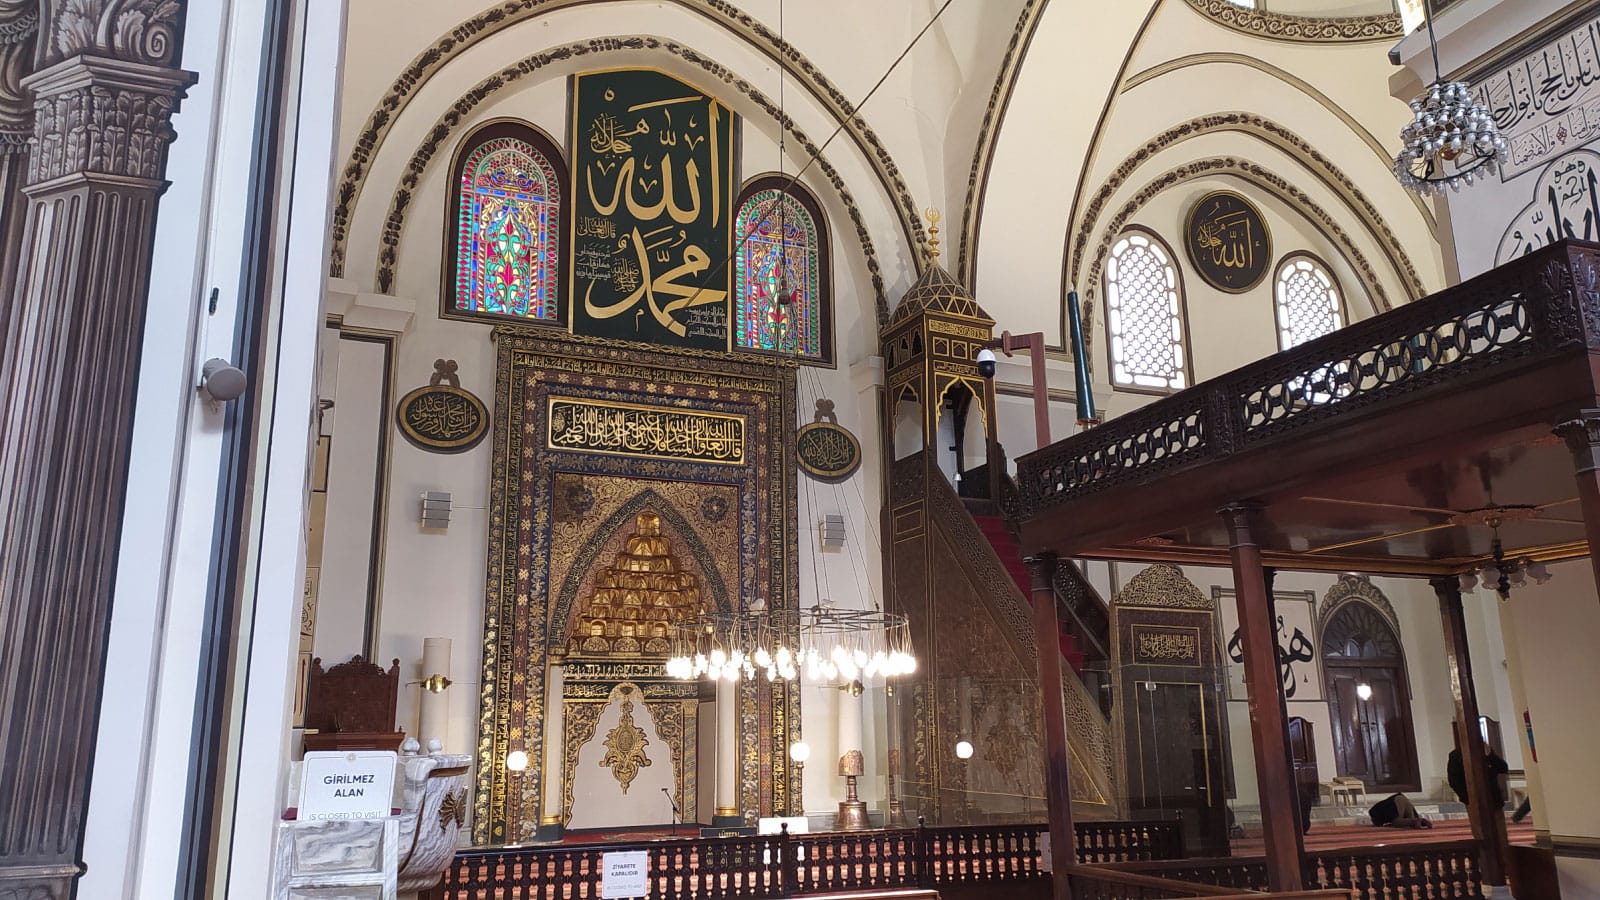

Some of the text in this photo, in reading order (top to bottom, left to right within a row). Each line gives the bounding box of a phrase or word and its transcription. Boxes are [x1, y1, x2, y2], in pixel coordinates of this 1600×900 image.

[323, 774, 375, 785] GİRİLMEZ
[334, 788, 364, 798] ALAN
[318, 812, 350, 821] CLOSED
[351, 811, 363, 819] TO
